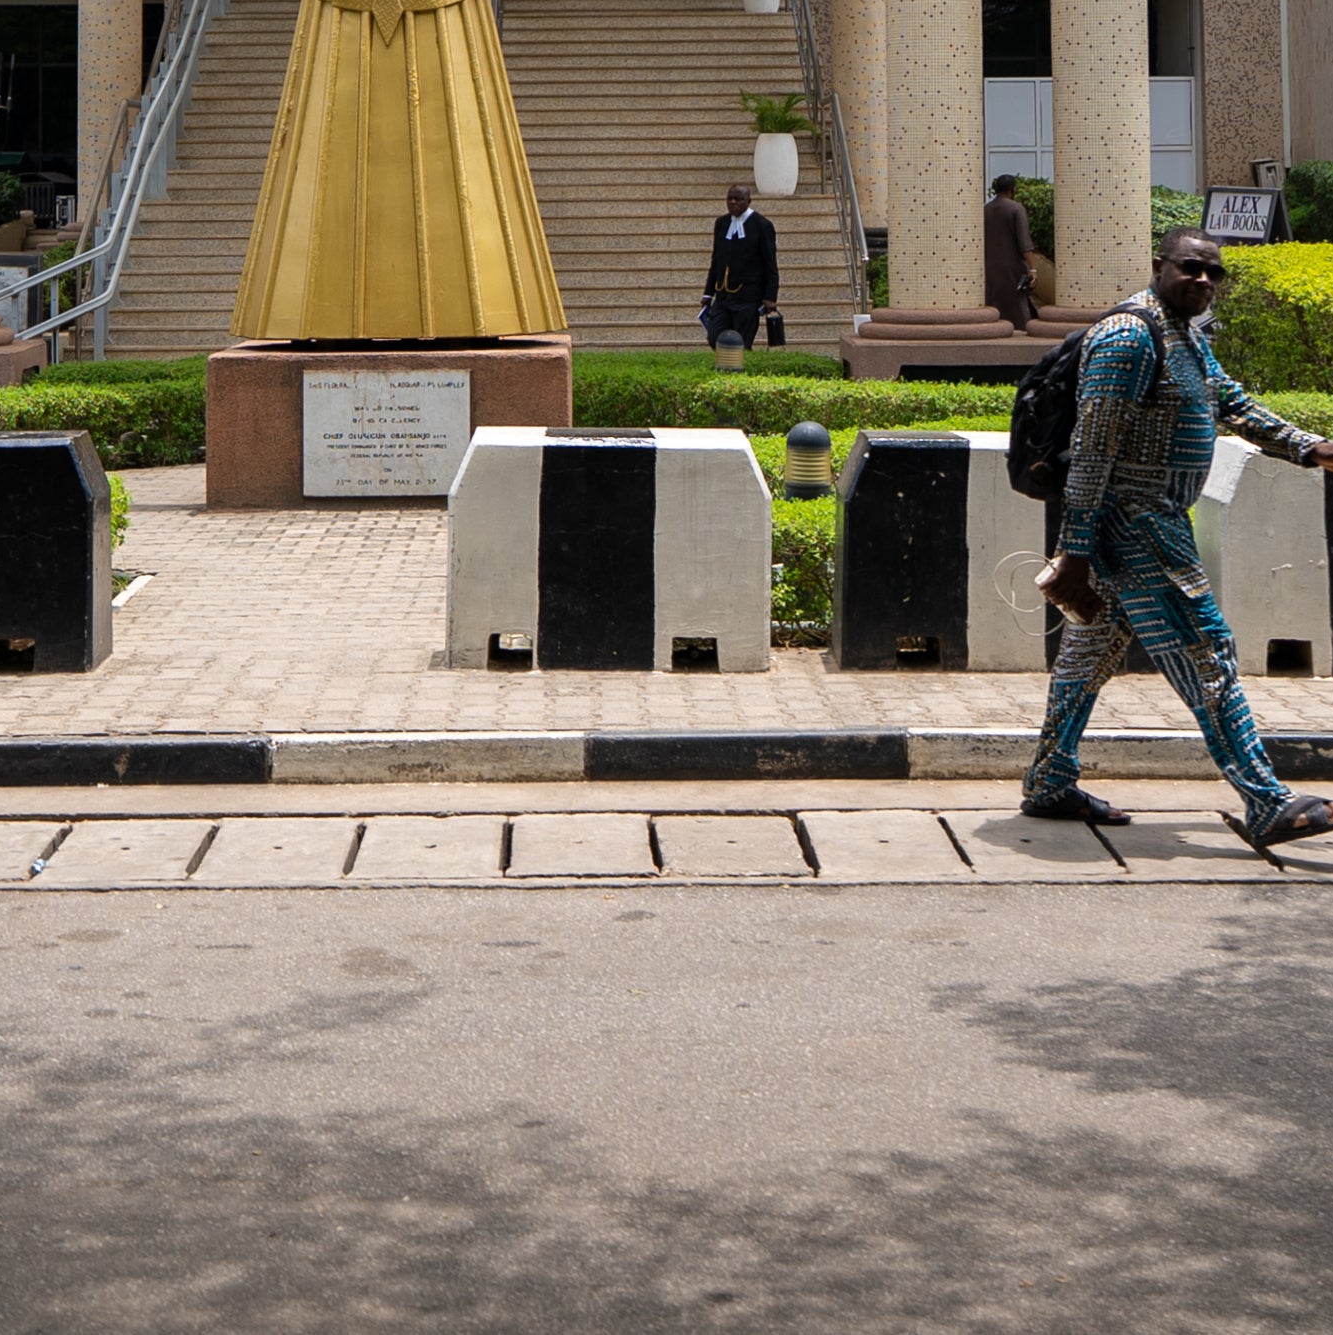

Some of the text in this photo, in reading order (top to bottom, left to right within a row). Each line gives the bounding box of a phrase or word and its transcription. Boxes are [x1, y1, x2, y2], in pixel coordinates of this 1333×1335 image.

[1221, 196, 1262, 214] ALEX
[1209, 214, 1268, 232] LAW BOOKS
